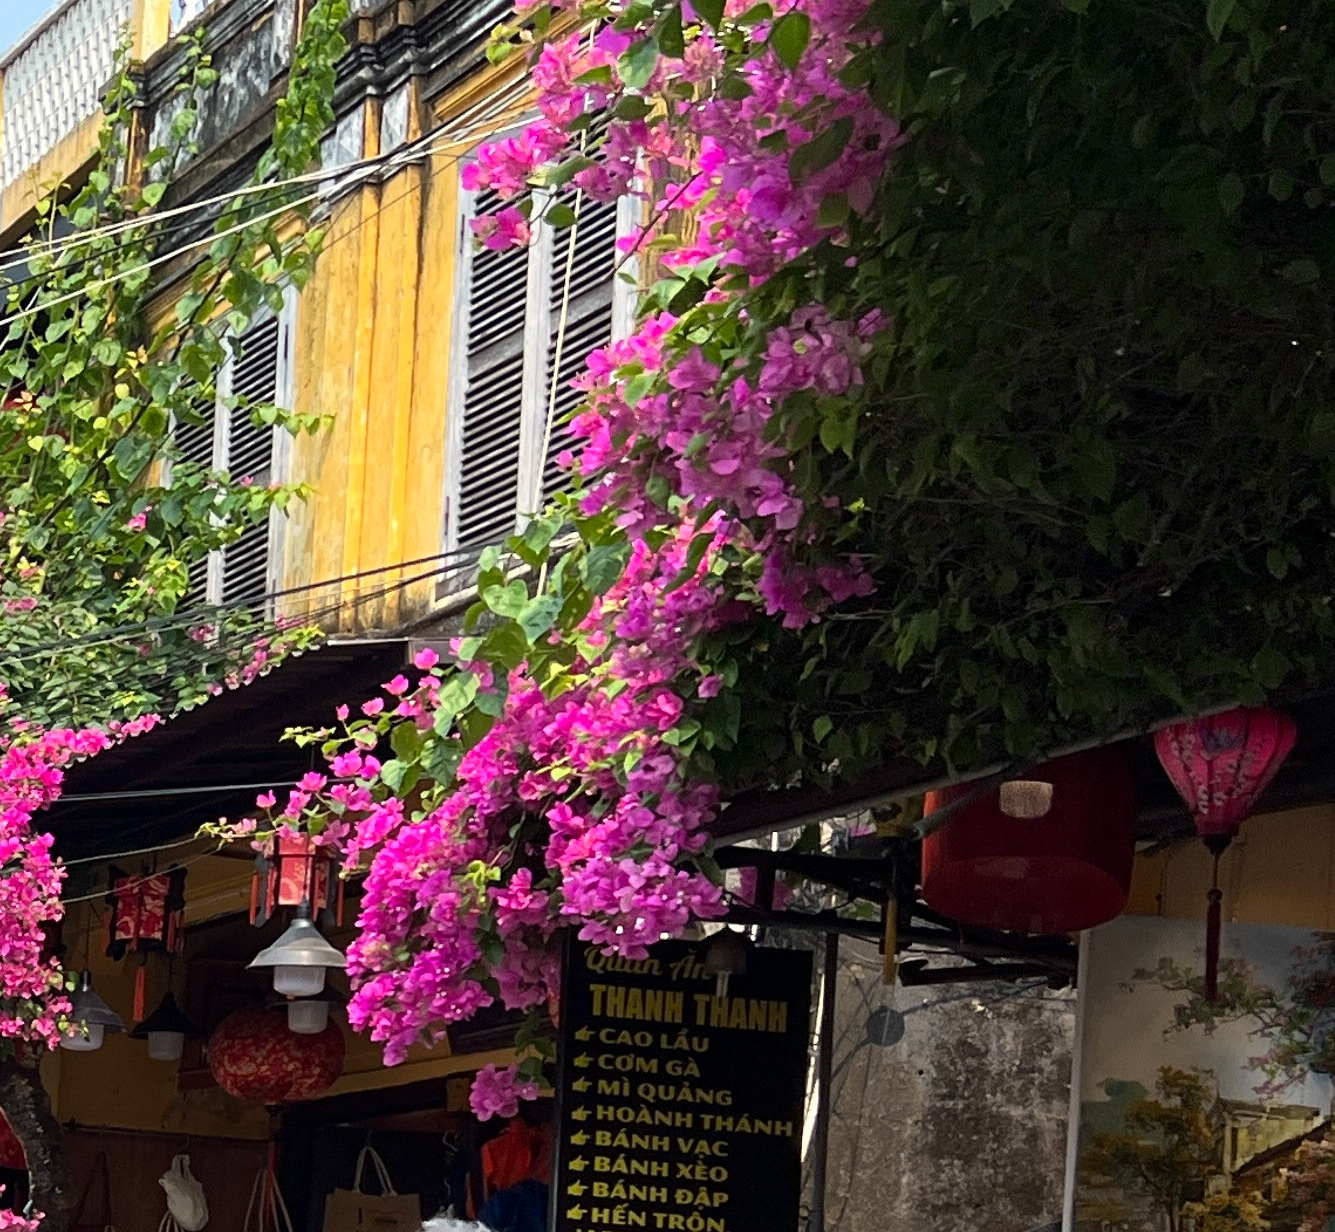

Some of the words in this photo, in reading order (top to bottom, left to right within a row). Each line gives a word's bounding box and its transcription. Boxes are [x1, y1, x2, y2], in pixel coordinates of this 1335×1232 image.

[589, 983, 684, 1024] THANH
[693, 993, 788, 1034] THANH
[599, 1028, 654, 1048] CAO
[597, 1052, 659, 1075] CƠM
[665, 1057, 701, 1078] GÀ
[597, 1076, 631, 1097] MÌ
[637, 1081, 733, 1106] QUẢNG
[596, 1103, 694, 1129] HOÀNH
[700, 1112, 793, 1138] THÁNH
[595, 1128, 670, 1152] BÁNH
[677, 1138, 729, 1159] VẠC
[594, 1154, 669, 1177] BÁNH
[676, 1160, 728, 1182] XÈO
[592, 1179, 668, 1203] BÁNH
[674, 1186, 729, 1210] ĐẬP
[591, 1202, 646, 1227] HẾN
